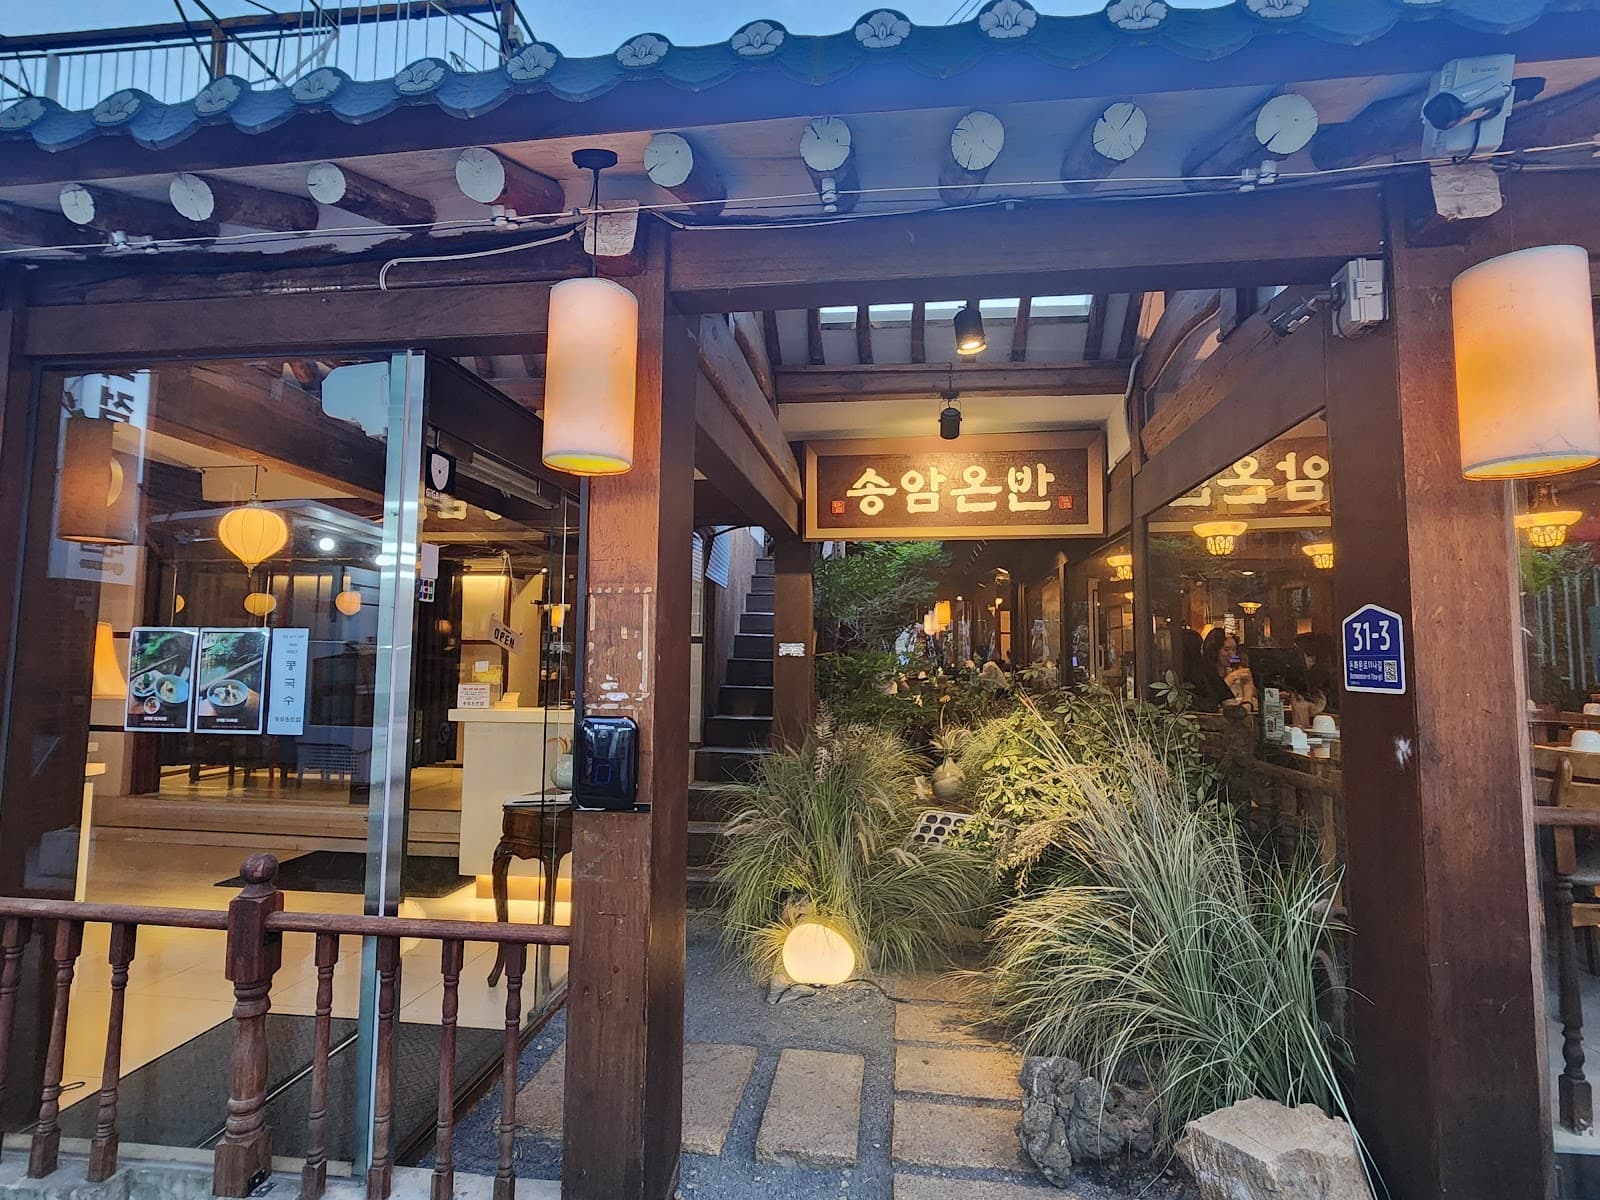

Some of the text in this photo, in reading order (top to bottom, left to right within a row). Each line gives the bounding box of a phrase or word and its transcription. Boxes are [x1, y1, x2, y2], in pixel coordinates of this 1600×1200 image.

[846, 463, 1055, 515] 송암온반
[494, 627, 515, 649] OPEN
[1352, 620, 1391, 652] 31-3
[282, 660, 297, 706] 콩국수
